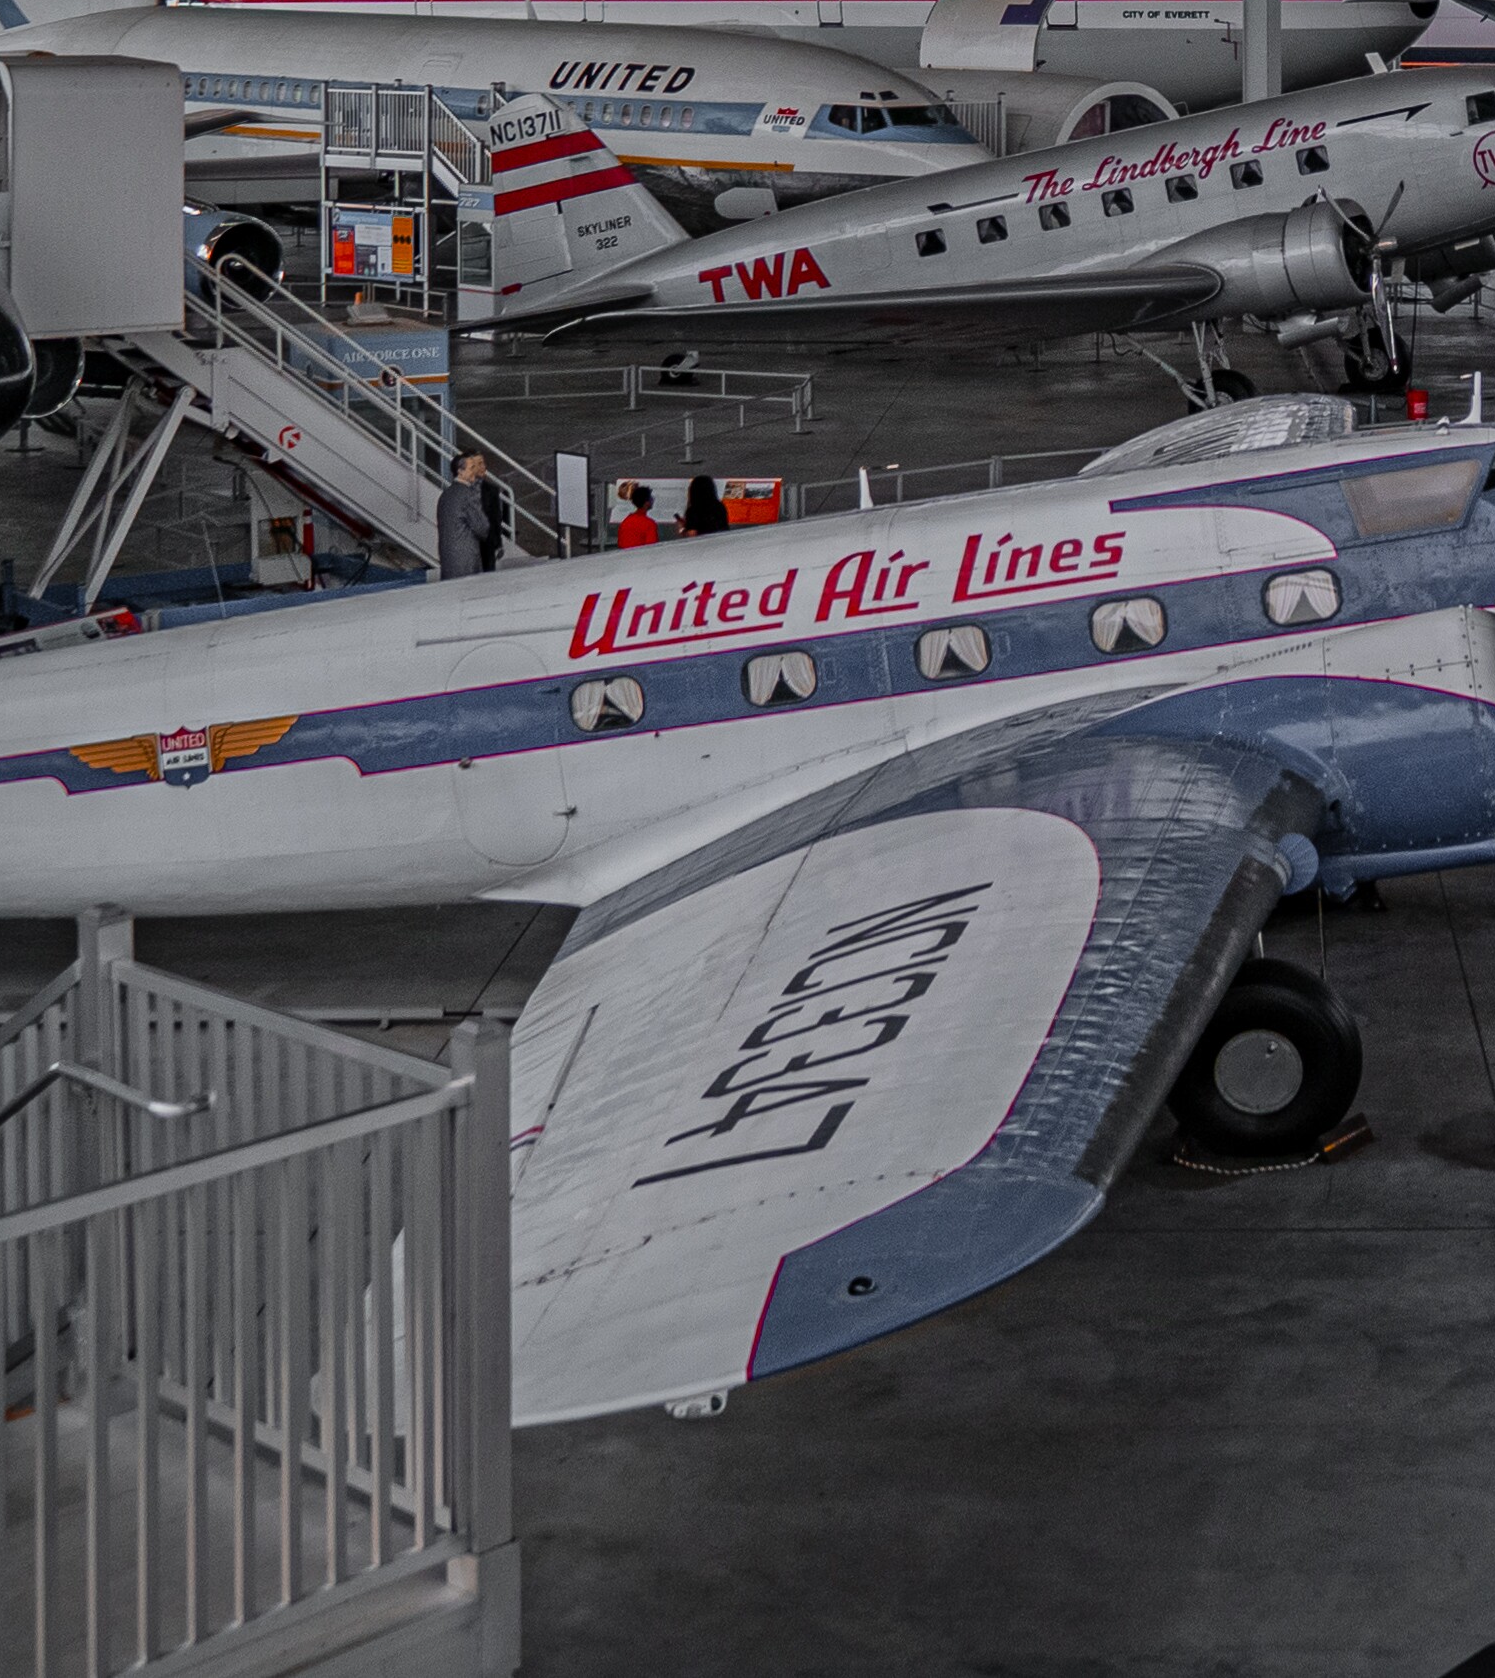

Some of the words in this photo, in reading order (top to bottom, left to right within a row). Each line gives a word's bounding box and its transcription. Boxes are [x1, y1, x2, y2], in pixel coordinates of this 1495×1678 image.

[1122, 10, 1145, 19] CITY
[1147, 10, 1161, 19] OF
[1164, 10, 1210, 19] EVERETT
[547, 60, 696, 94] UNITED
[489, 109, 562, 146] NC13711
[762, 113, 805, 127] UNITED
[1021, 168, 1075, 204] The
[1081, 126, 1243, 191] Lindbergh
[1251, 117, 1327, 154] Line
[458, 197, 481, 208] 727
[577, 215, 632, 237] SKYLINER
[595, 235, 619, 250] 322
[698, 247, 832, 303] TWA
[412, 347, 440, 358] ONE
[568, 568, 799, 659] United
[815, 549, 930, 623] Air
[952, 530, 1126, 604] Lines
[161, 732, 206, 751] UNITED
[631, 882, 994, 1189] NC13347
